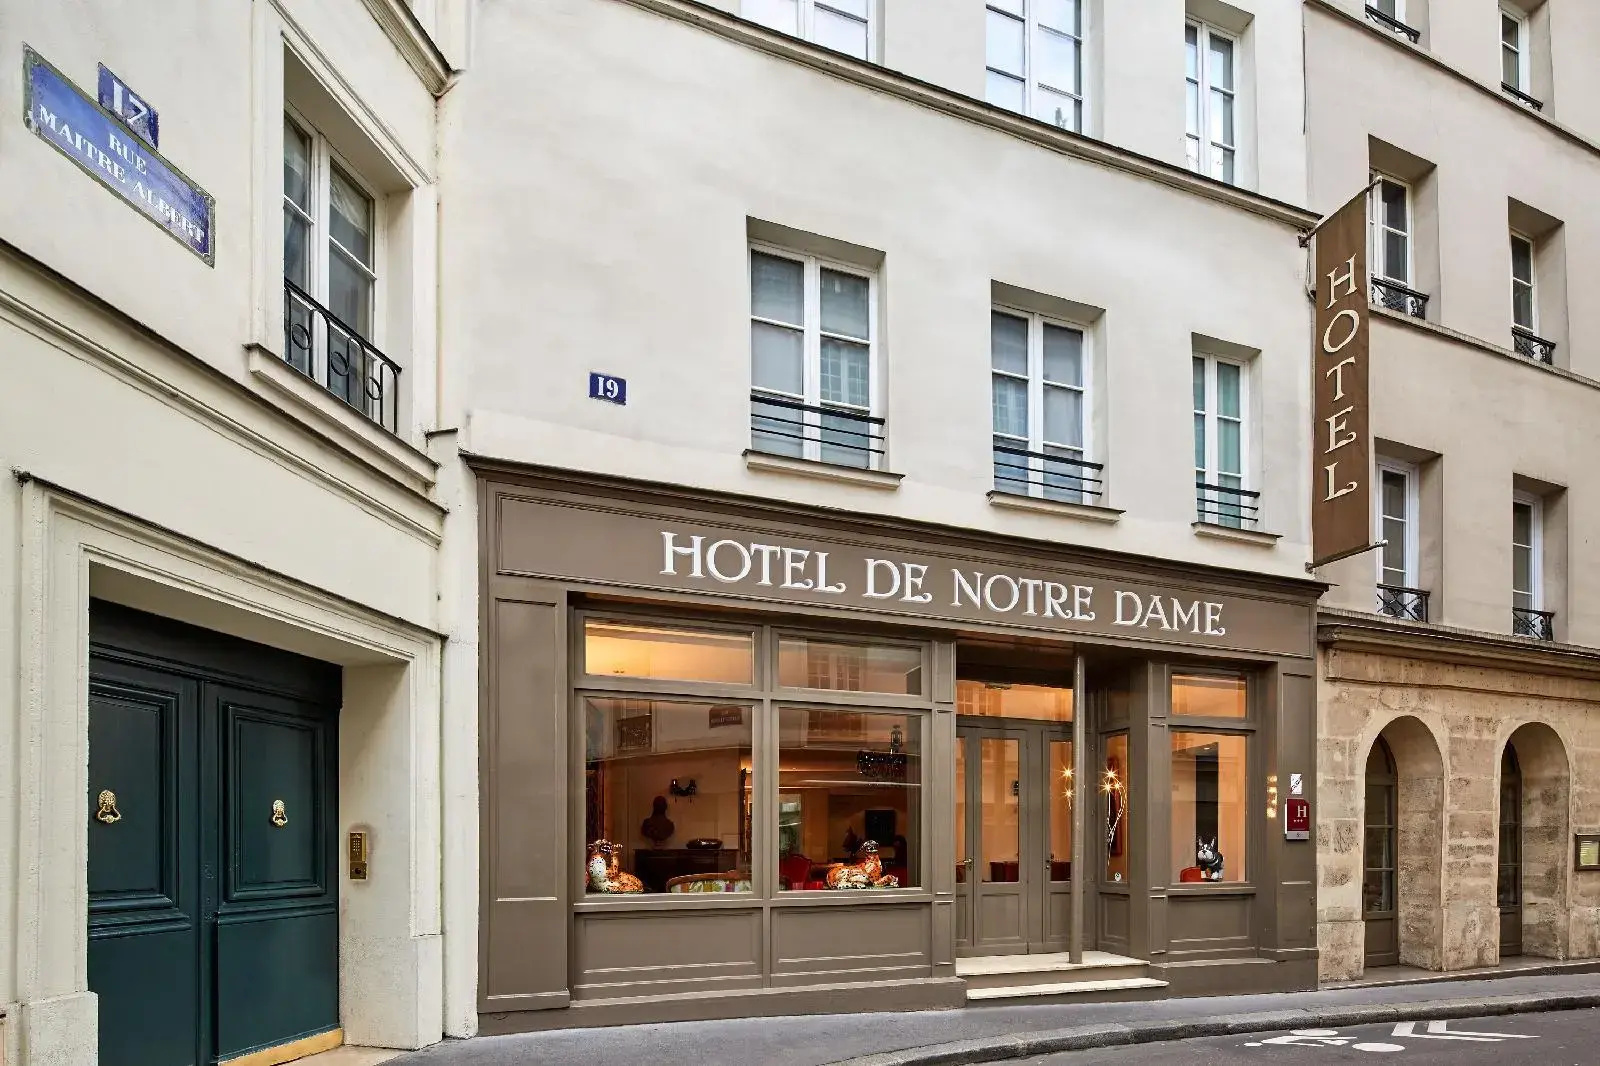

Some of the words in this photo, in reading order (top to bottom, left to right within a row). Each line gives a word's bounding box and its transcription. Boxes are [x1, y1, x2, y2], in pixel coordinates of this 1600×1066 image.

[113, 79, 148, 126] 17
[39, 104, 125, 183] MAITRE
[132, 181, 205, 243] ALBERT
[109, 133, 147, 175] RUE
[597, 376, 619, 399] 19
[1322, 252, 1360, 502] HOTEL
[659, 531, 847, 593] HOTEL
[862, 558, 933, 604] DE
[951, 568, 1096, 621] NOTRE
[1111, 590, 1226, 637] DAME
[1296, 805, 1308, 818] H
